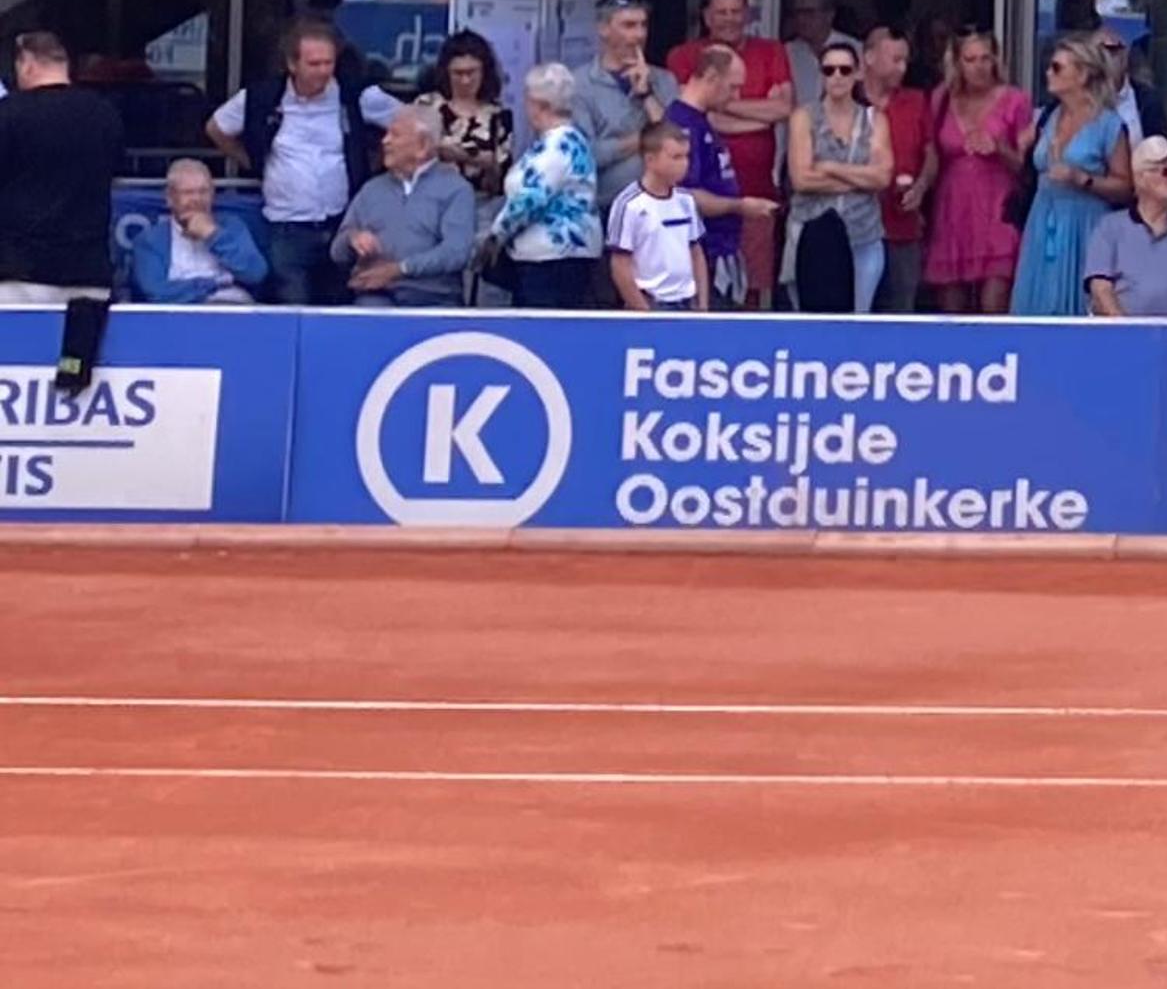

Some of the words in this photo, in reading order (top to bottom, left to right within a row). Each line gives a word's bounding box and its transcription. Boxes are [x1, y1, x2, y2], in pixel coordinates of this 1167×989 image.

[623, 348, 1018, 402] Fascinerend
[422, 384, 511, 484] K
[621, 411, 898, 477] Koksijde
[615, 474, 1089, 531] Oostduinkerke
